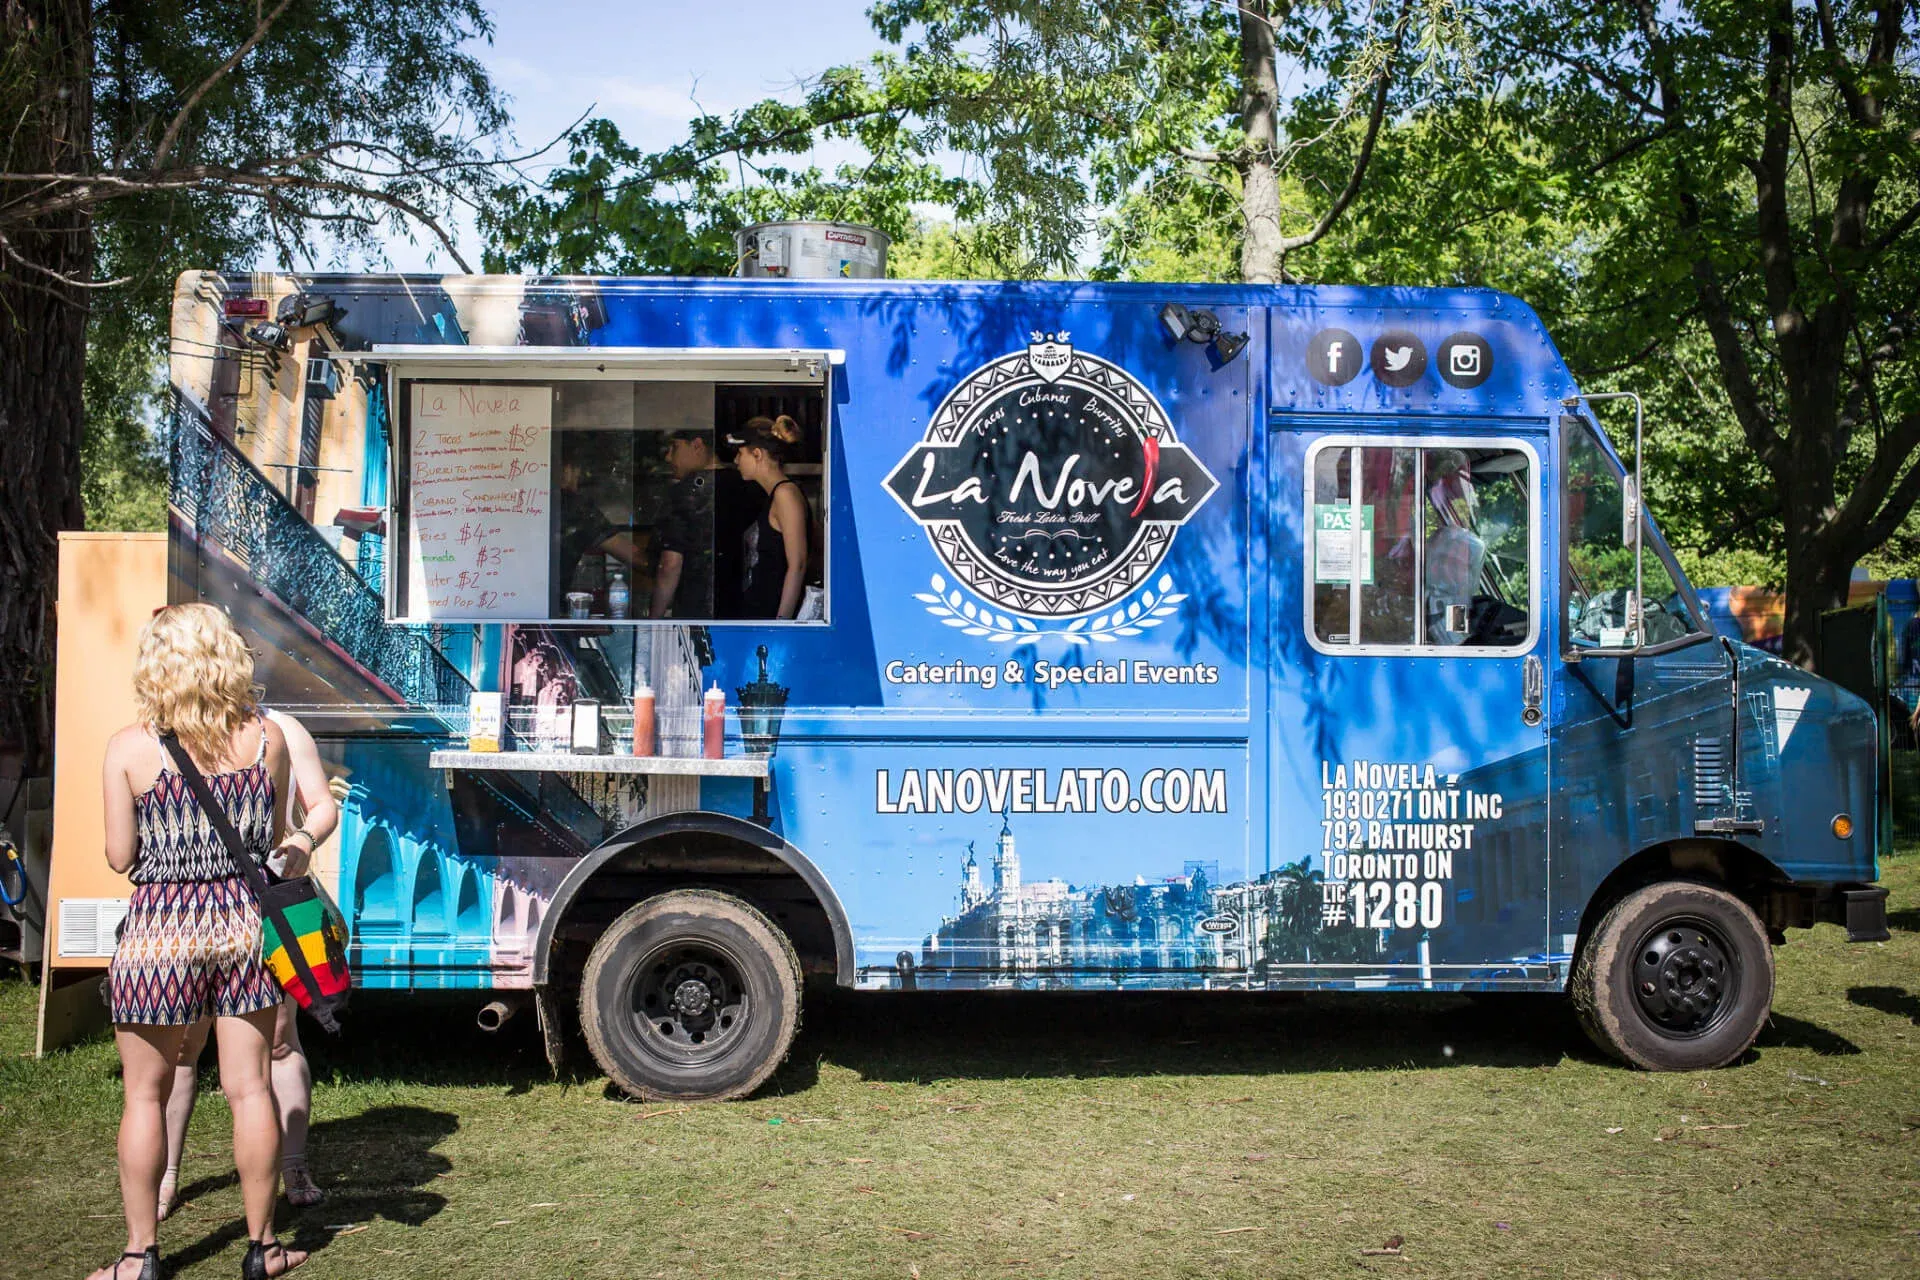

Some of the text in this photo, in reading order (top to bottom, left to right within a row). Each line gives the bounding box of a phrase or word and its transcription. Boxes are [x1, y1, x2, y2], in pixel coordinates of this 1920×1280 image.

[420, 386, 447, 417] La
[971, 387, 1127, 438] Tacos Cubanos Burritos
[415, 430, 427, 449] 2
[912, 440, 1190, 517] La Novela
[996, 511, 1102, 524] Fresh Latin Grill
[994, 547, 1109, 582] Love the way you eat
[885, 660, 1219, 689] Catering & Special Events
[1322, 760, 1437, 789] LA NOVELA
[876, 768, 1228, 813] LANOVELATO.COM
[1321, 790, 1503, 820] 1930271 ONT INC
[1321, 820, 1475, 850] 792 BATHURST
[1321, 850, 1453, 879] TORONTO ON
[1322, 884, 1346, 903] LIC
[1349, 881, 1443, 929] 1280
